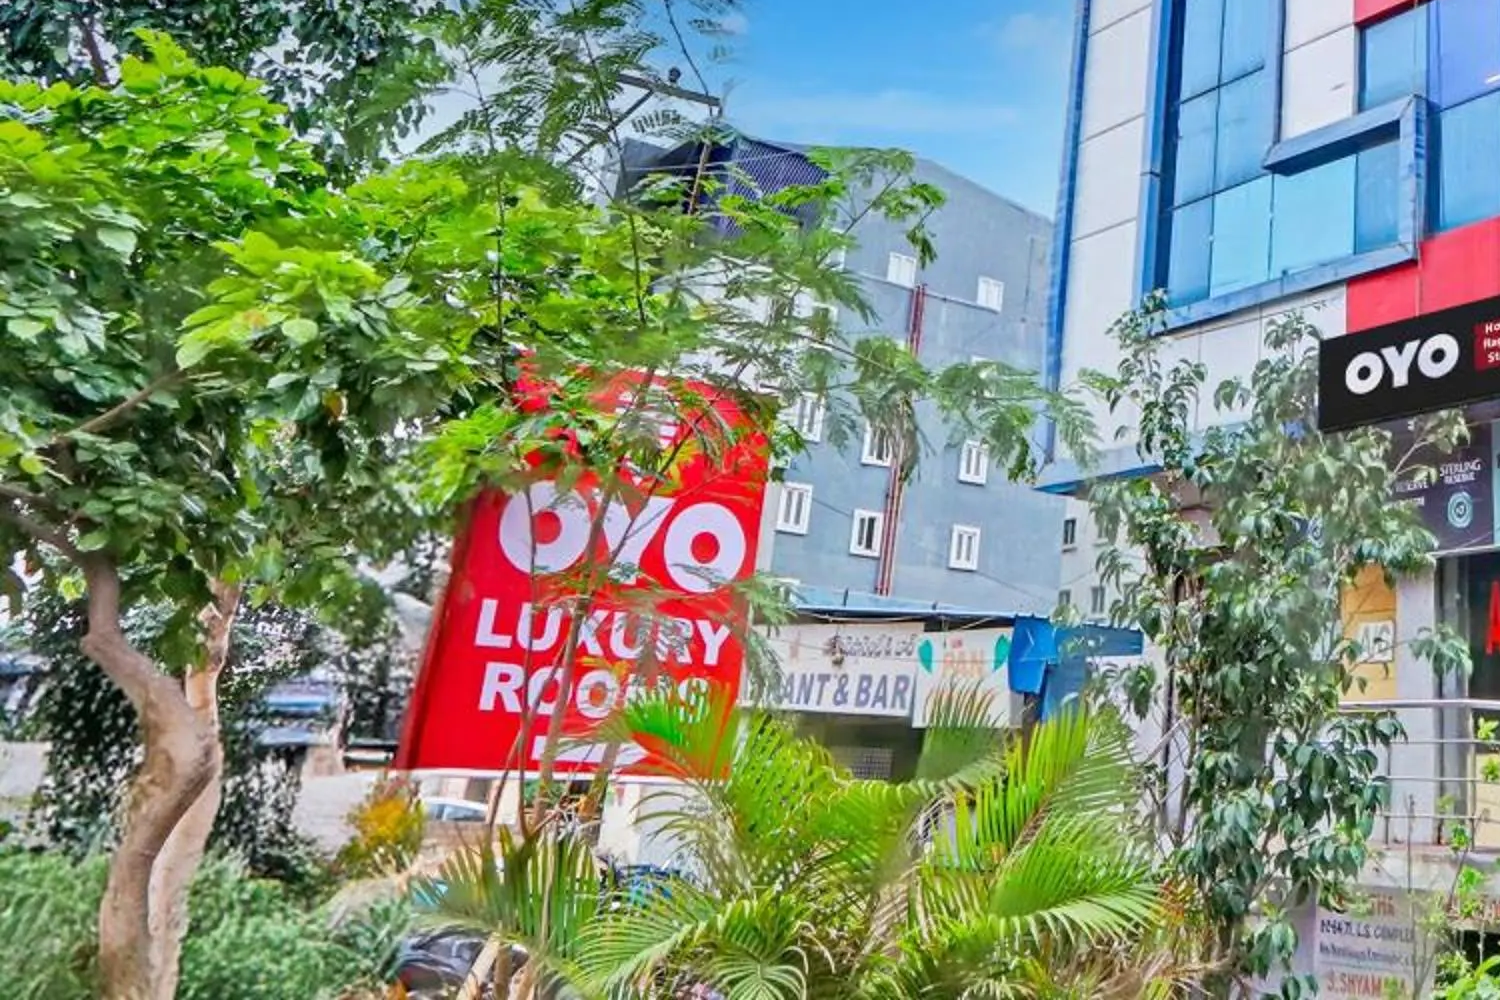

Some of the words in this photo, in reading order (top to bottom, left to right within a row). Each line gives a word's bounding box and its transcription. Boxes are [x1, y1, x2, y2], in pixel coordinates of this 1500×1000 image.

[1345, 333, 1460, 396] OYO
[499, 480, 747, 593] OYO
[474, 598, 731, 665] LUXURY
[833, 673, 850, 706] &
[854, 674, 910, 710] BAR
